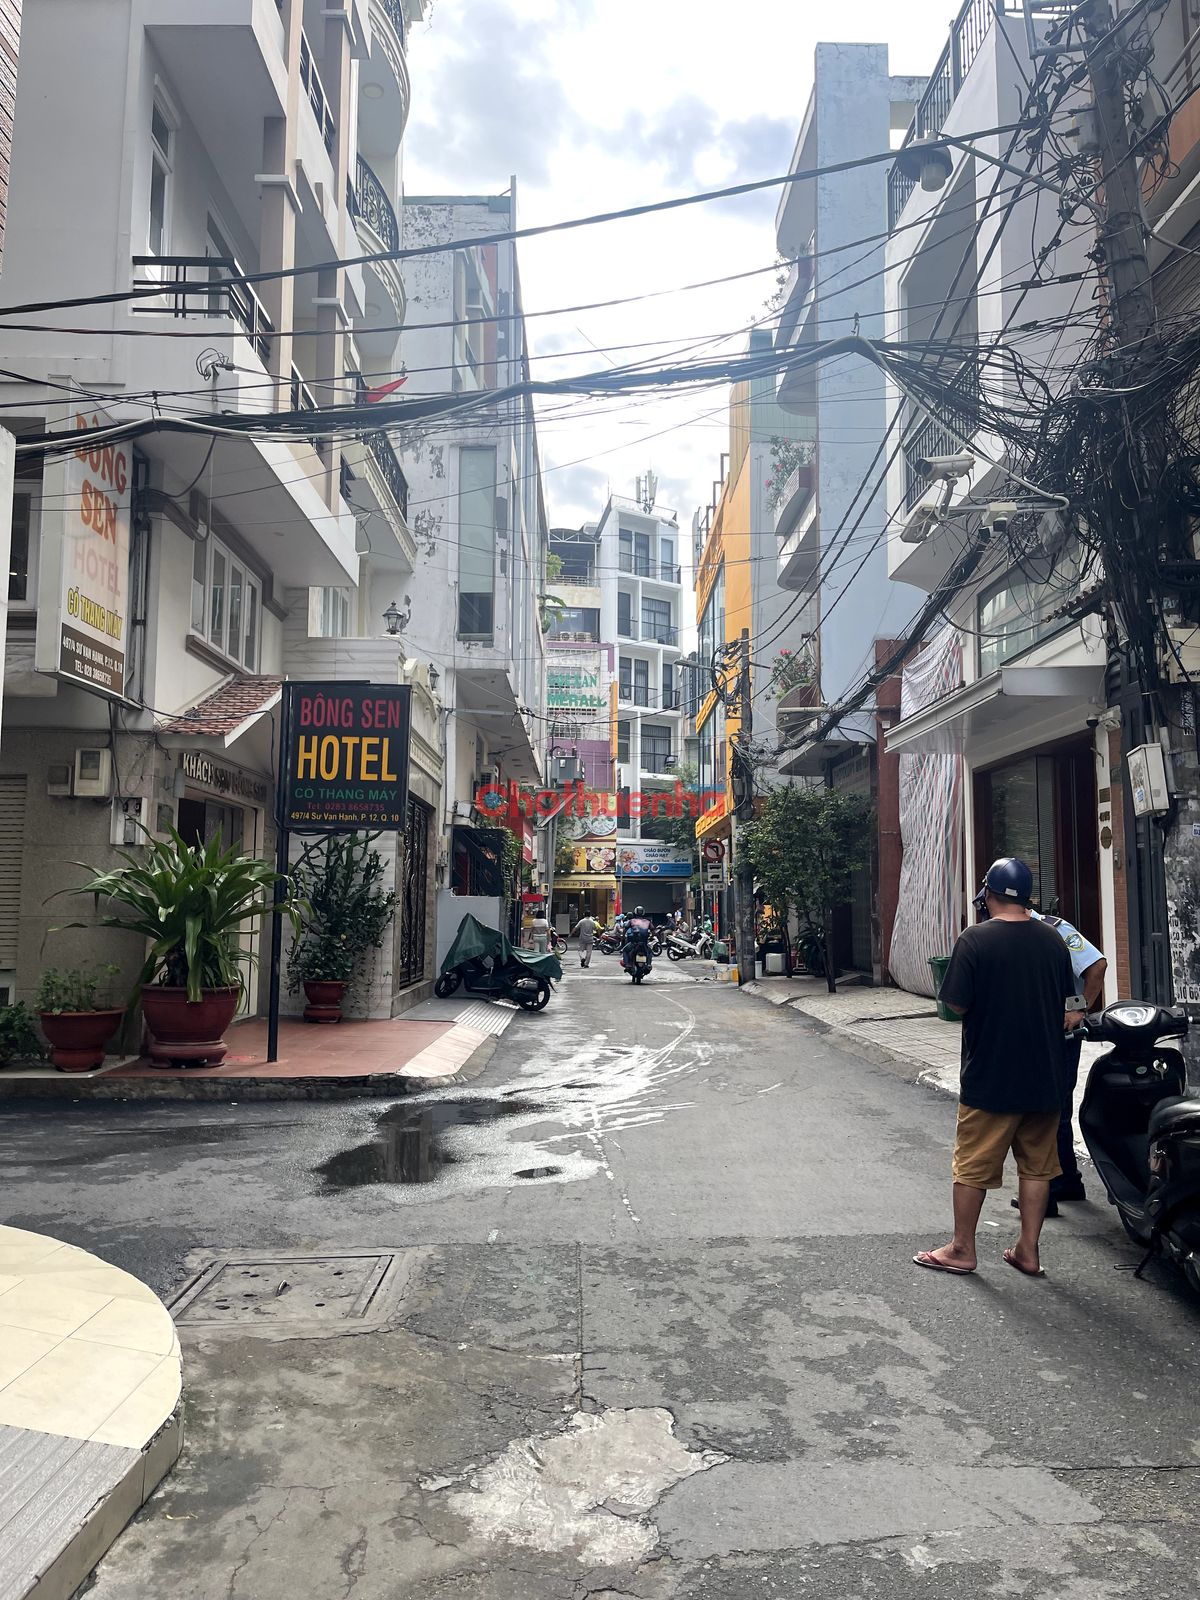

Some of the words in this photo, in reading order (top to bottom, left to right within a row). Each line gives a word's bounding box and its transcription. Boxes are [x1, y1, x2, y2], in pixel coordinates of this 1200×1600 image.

[80, 479, 118, 545] SEN
[73, 543, 120, 597] HOTEL
[80, 595, 105, 633] THANG
[300, 692, 354, 729] BÔNG
[361, 698, 400, 729] SEN
[297, 735, 397, 782] HOTEL
[319, 788, 364, 801] THANG
[368, 786, 397, 801] MÁY
[291, 811, 310, 820] 497/4
[391, 814, 399, 822] 10
